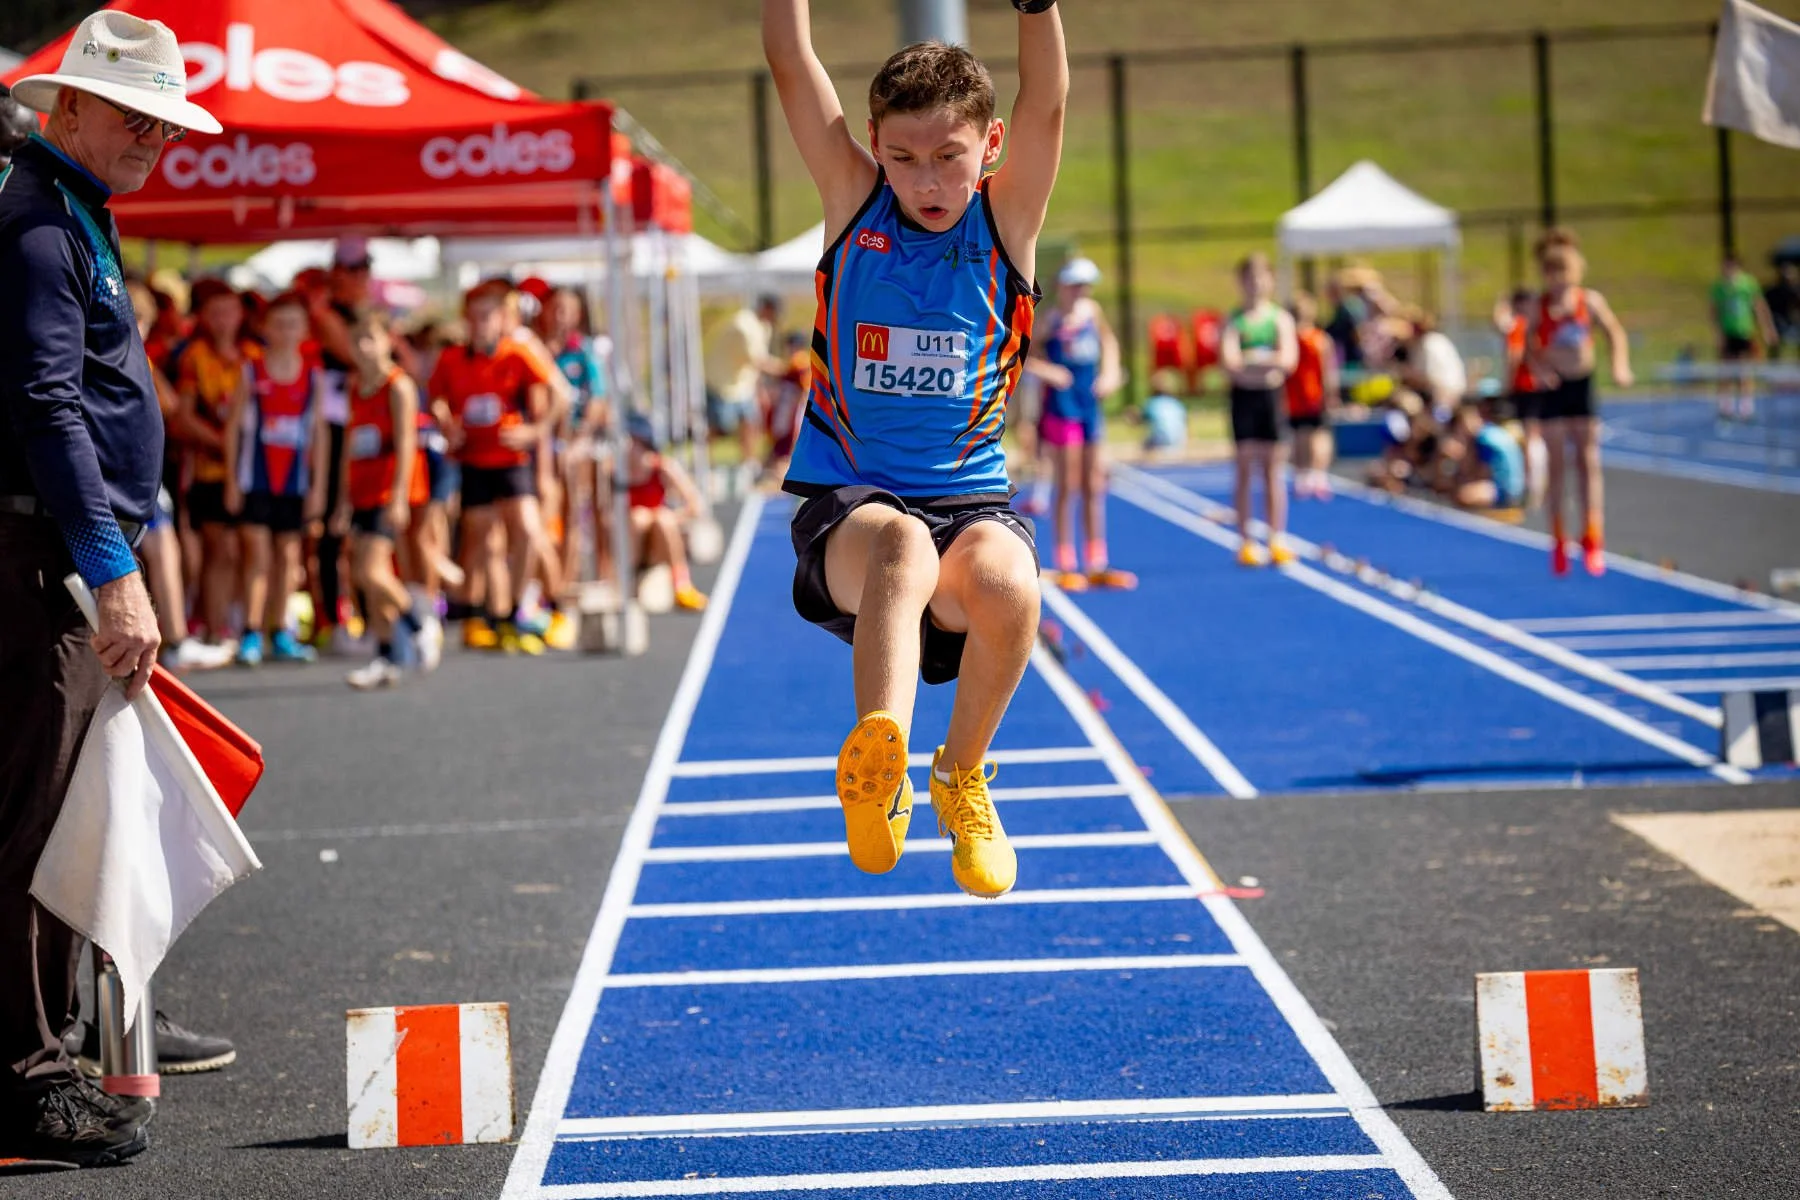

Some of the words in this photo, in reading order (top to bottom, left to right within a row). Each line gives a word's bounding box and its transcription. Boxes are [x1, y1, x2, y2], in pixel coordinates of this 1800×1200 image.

[180, 22, 411, 107] oles
[163, 134, 317, 189] coles
[421, 121, 576, 179] coles
[917, 335, 954, 353] U11
[865, 363, 955, 392] 15420
